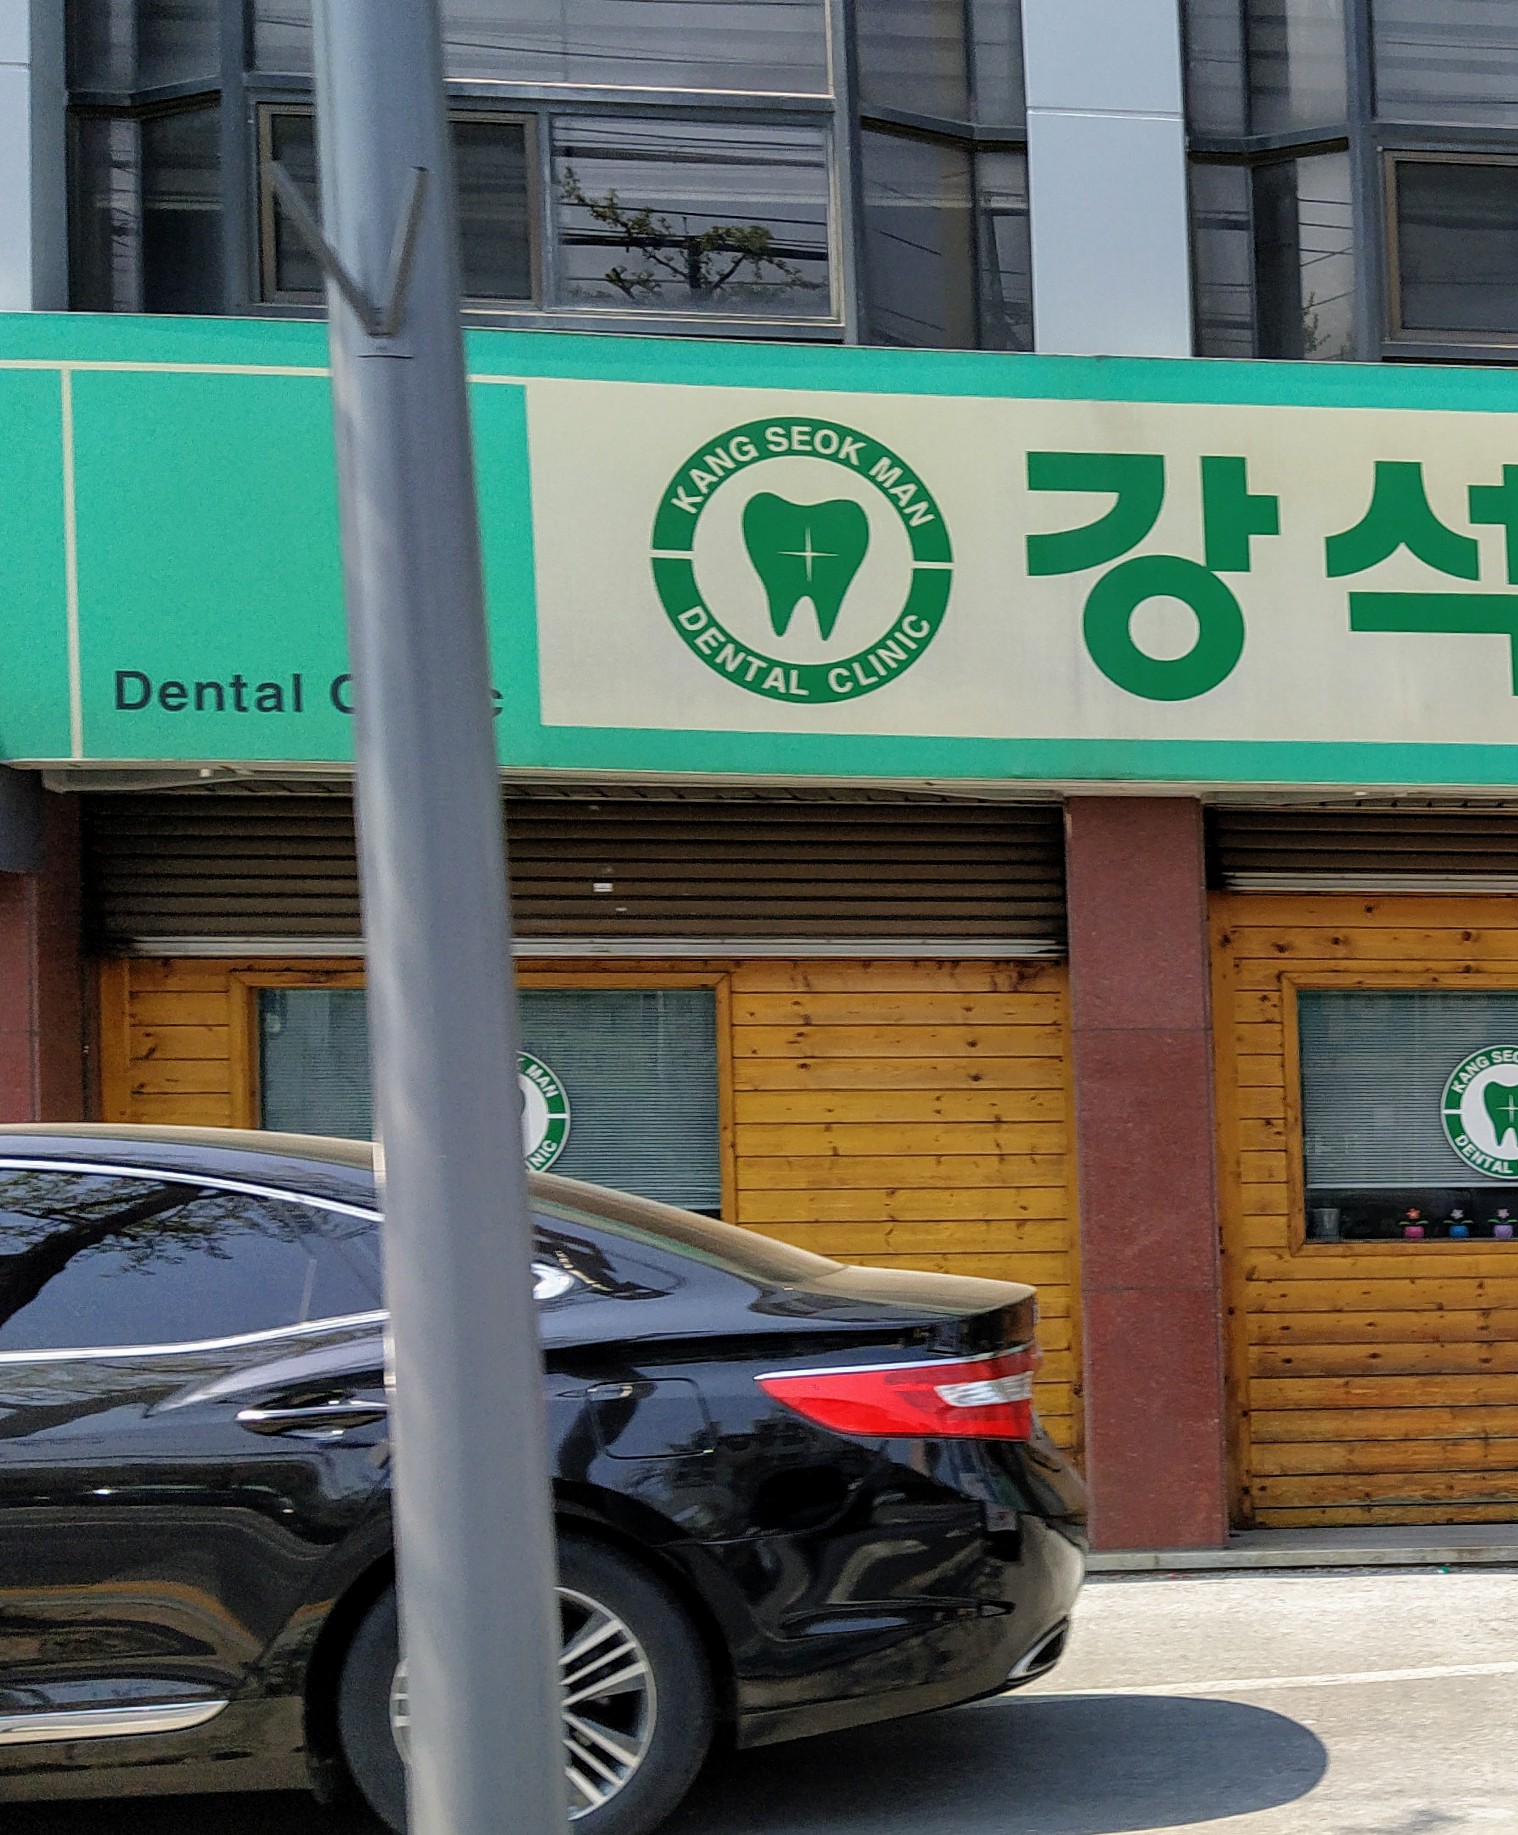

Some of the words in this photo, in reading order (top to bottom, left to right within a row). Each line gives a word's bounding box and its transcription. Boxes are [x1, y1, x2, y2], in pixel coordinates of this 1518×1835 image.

[671, 436, 760, 515] KANG
[765, 426, 867, 466] SEOK
[869, 456, 935, 528] MAN
[677, 605, 810, 696] DENTAL
[828, 614, 931, 694] CLINIC
[114, 670, 304, 713] Dental
[525, 1064, 559, 1098] MAN
[1451, 1056, 1490, 1095] KANG
[1455, 1134, 1513, 1174] DENTAL
